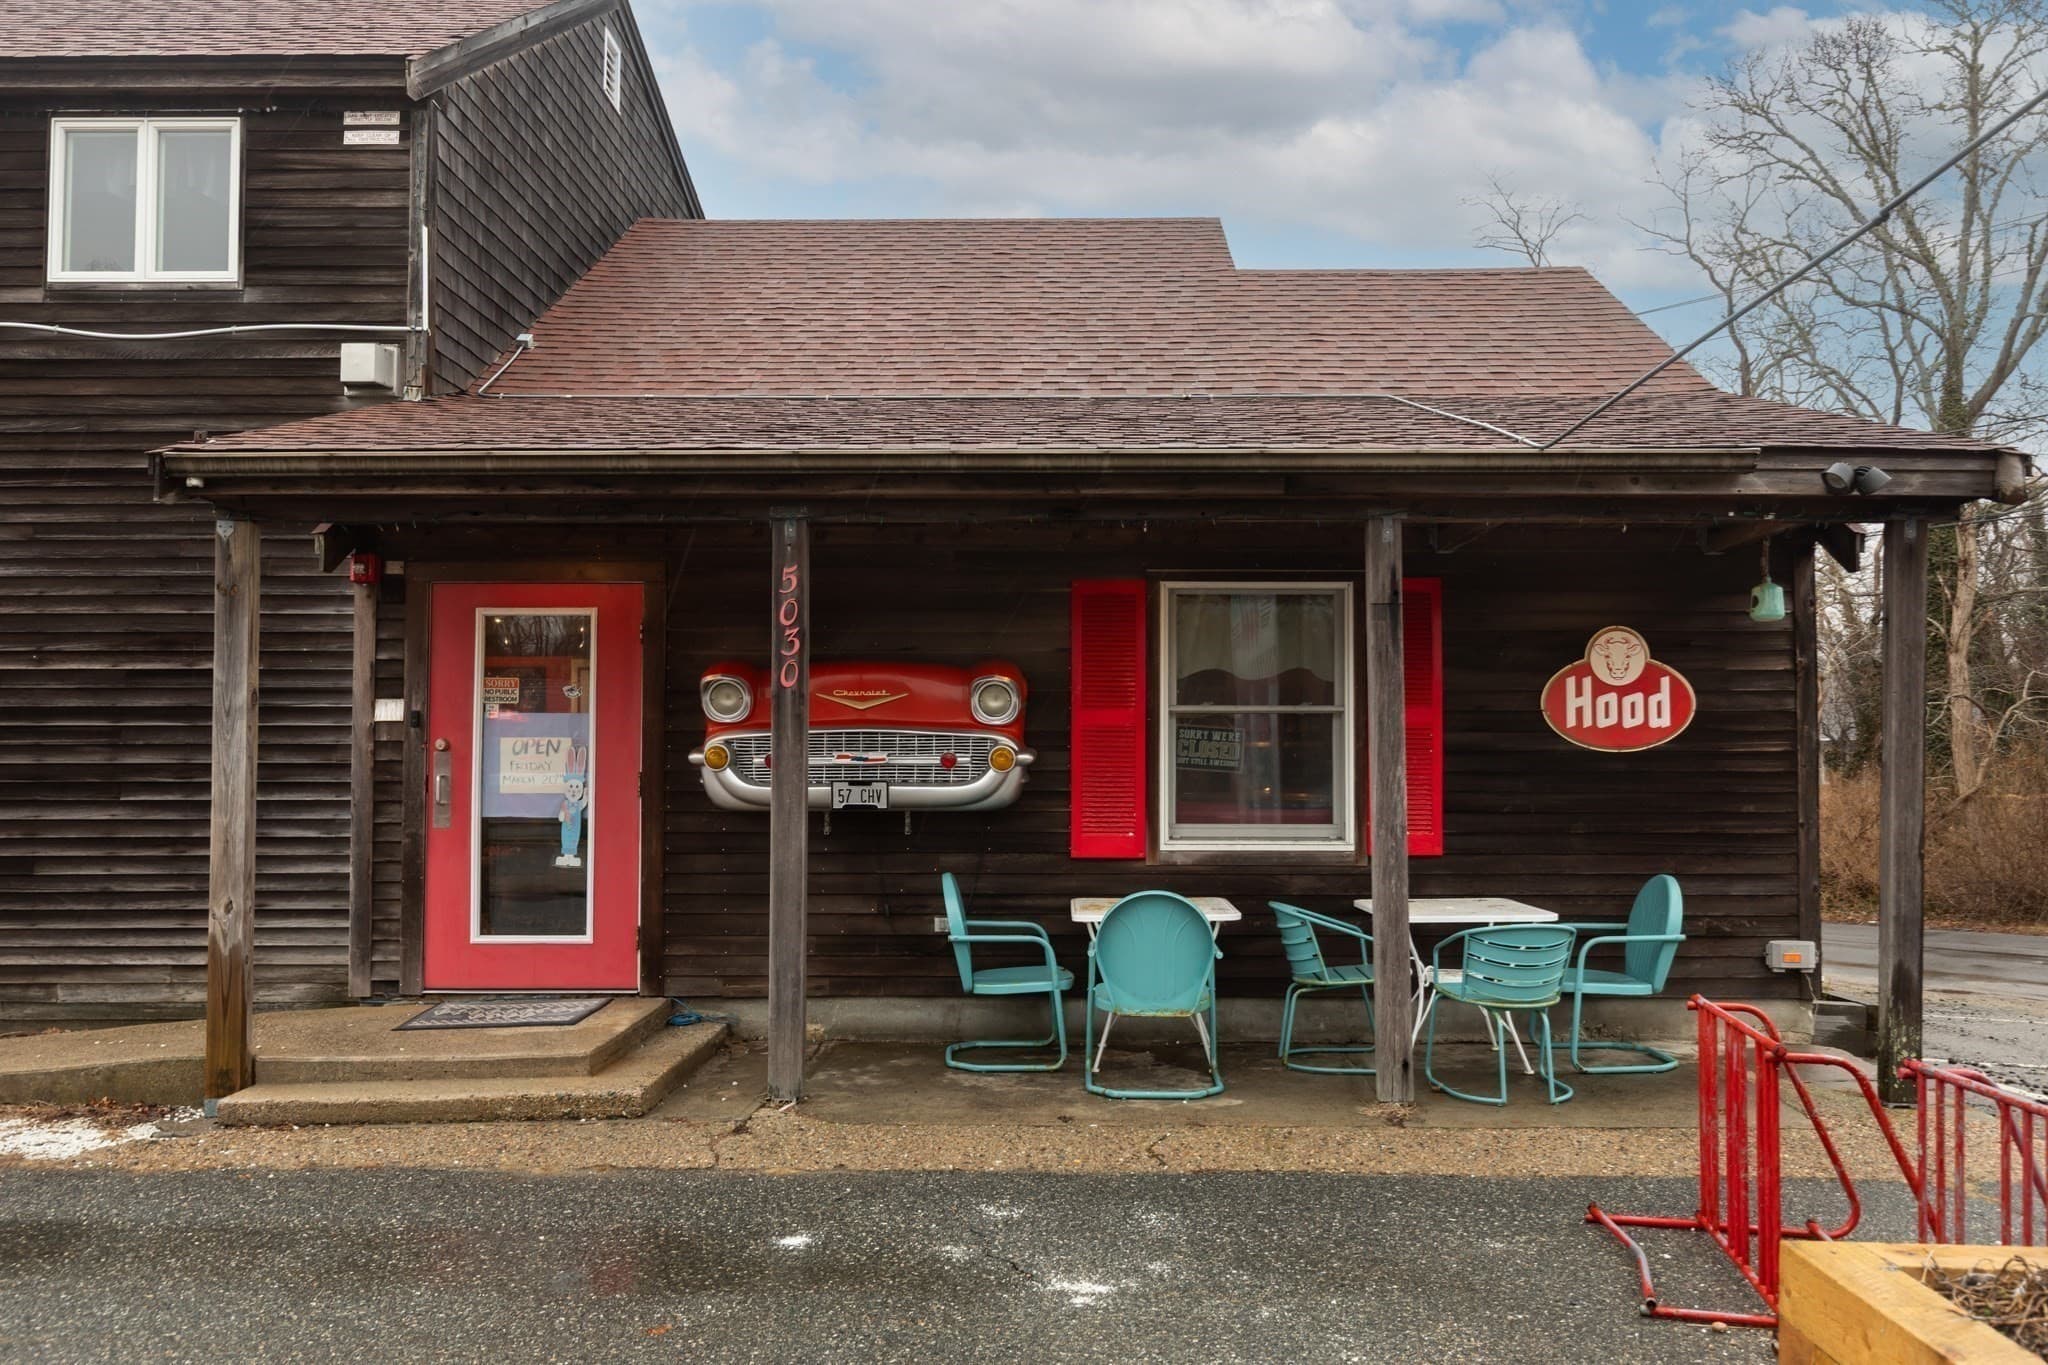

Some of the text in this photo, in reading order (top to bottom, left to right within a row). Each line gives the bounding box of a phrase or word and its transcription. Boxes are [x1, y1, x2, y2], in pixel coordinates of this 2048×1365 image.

[779, 564, 800, 687] 5030
[485, 679, 517, 688] SORRY
[1565, 675, 1671, 729] Hood
[1178, 728, 1209, 740] SORRY
[511, 738, 561, 757] OPEN
[1177, 738, 1241, 761] CLOSED
[510, 760, 552, 771] FRIDAY
[838, 788, 882, 804] 57 CHV
